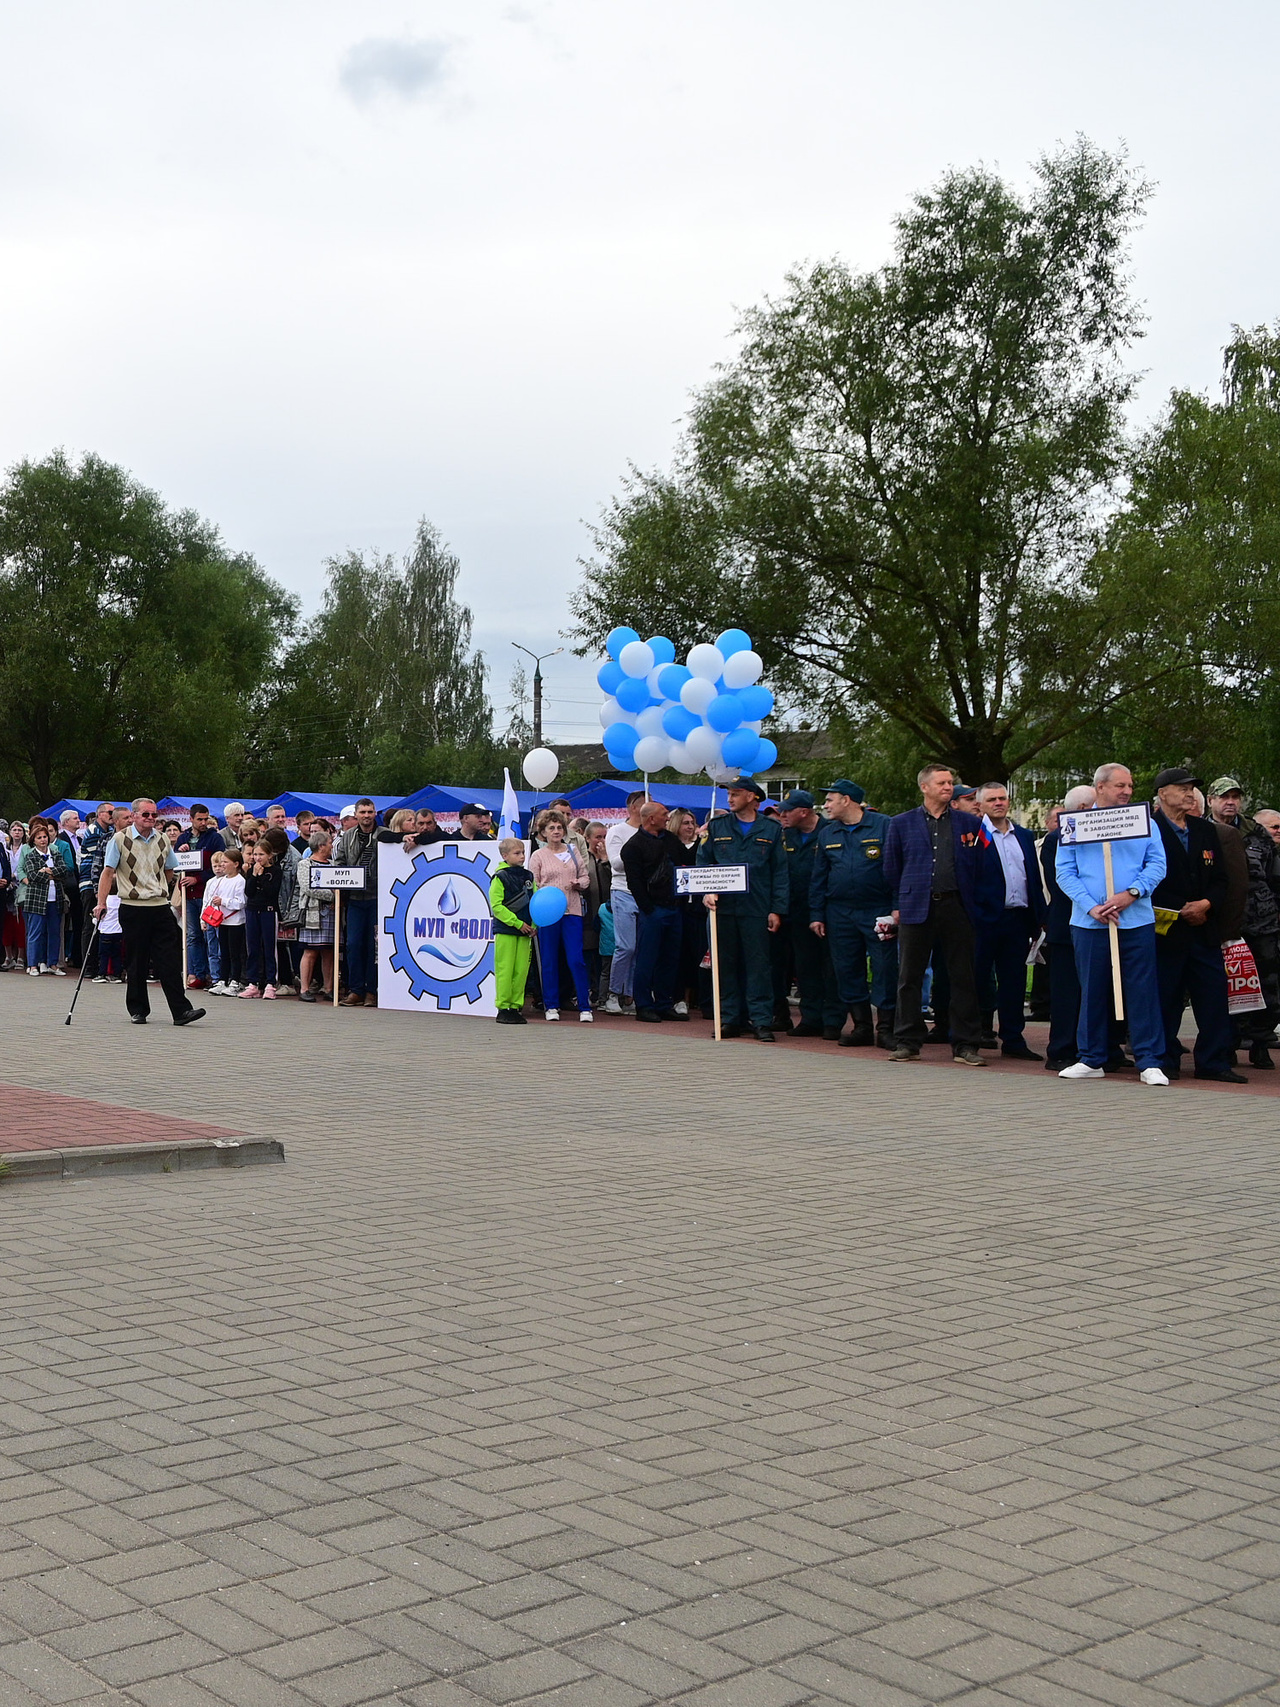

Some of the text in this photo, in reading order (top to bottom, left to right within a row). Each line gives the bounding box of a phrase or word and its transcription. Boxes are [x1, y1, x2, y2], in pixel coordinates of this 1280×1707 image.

[1085, 809, 1130, 818] ВЕТЕРАНСКАЯ
[1077, 816, 1124, 826] ОРГАНИЗАЦИЯ
[1090, 822, 1134, 832] ЗАВОЛЖСКОМ
[413, 917, 445, 939] МУП
